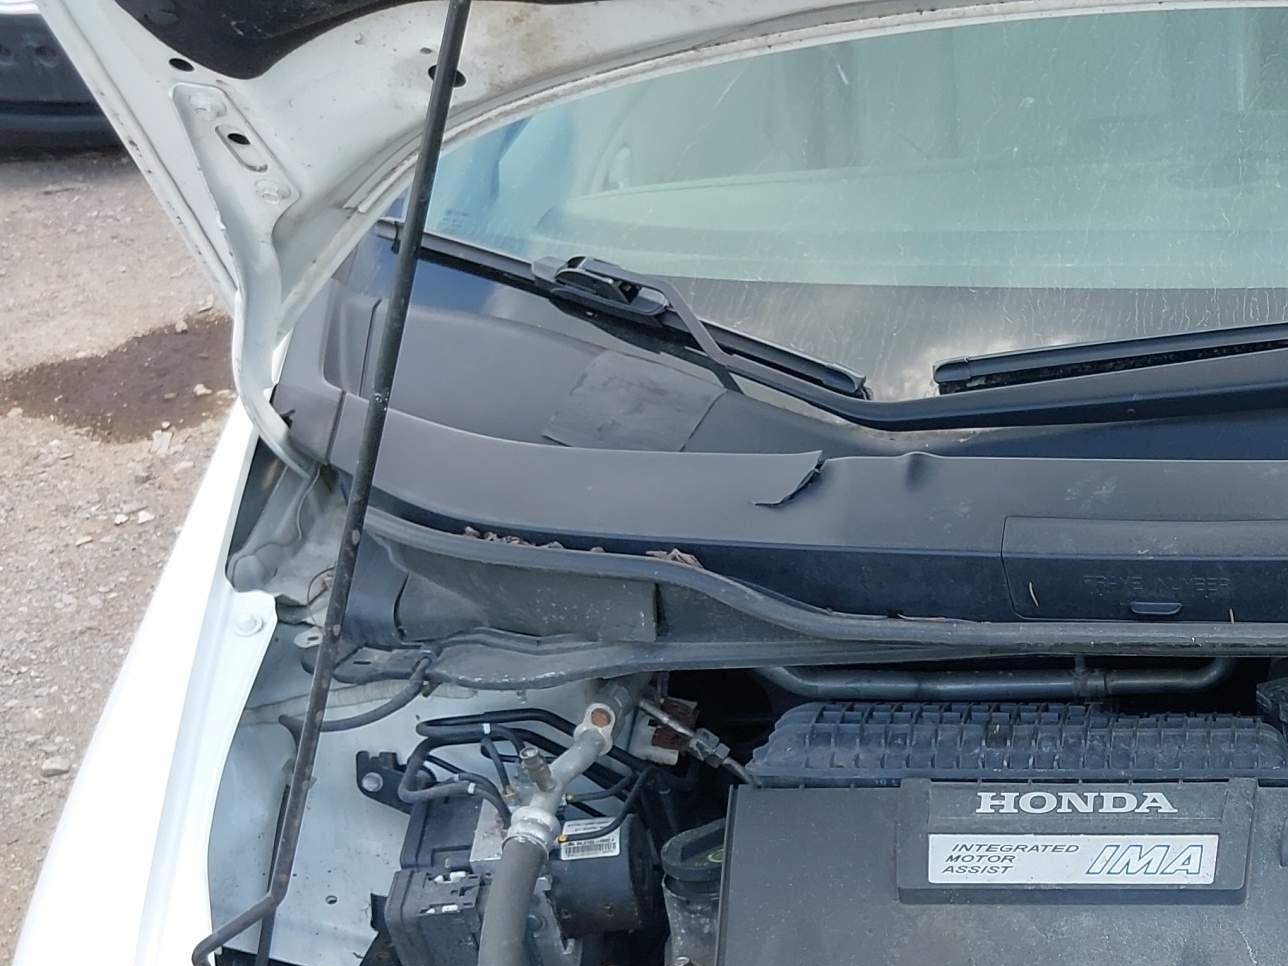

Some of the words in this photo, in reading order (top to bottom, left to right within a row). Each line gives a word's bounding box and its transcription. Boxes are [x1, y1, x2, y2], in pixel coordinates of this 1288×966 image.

[976, 791, 1178, 814] HONDA
[951, 843, 1080, 853] INTEGRATED
[945, 854, 1016, 864] MOTOR
[1086, 844, 1204, 875] IMA
[941, 865, 1014, 874] ASSIST
